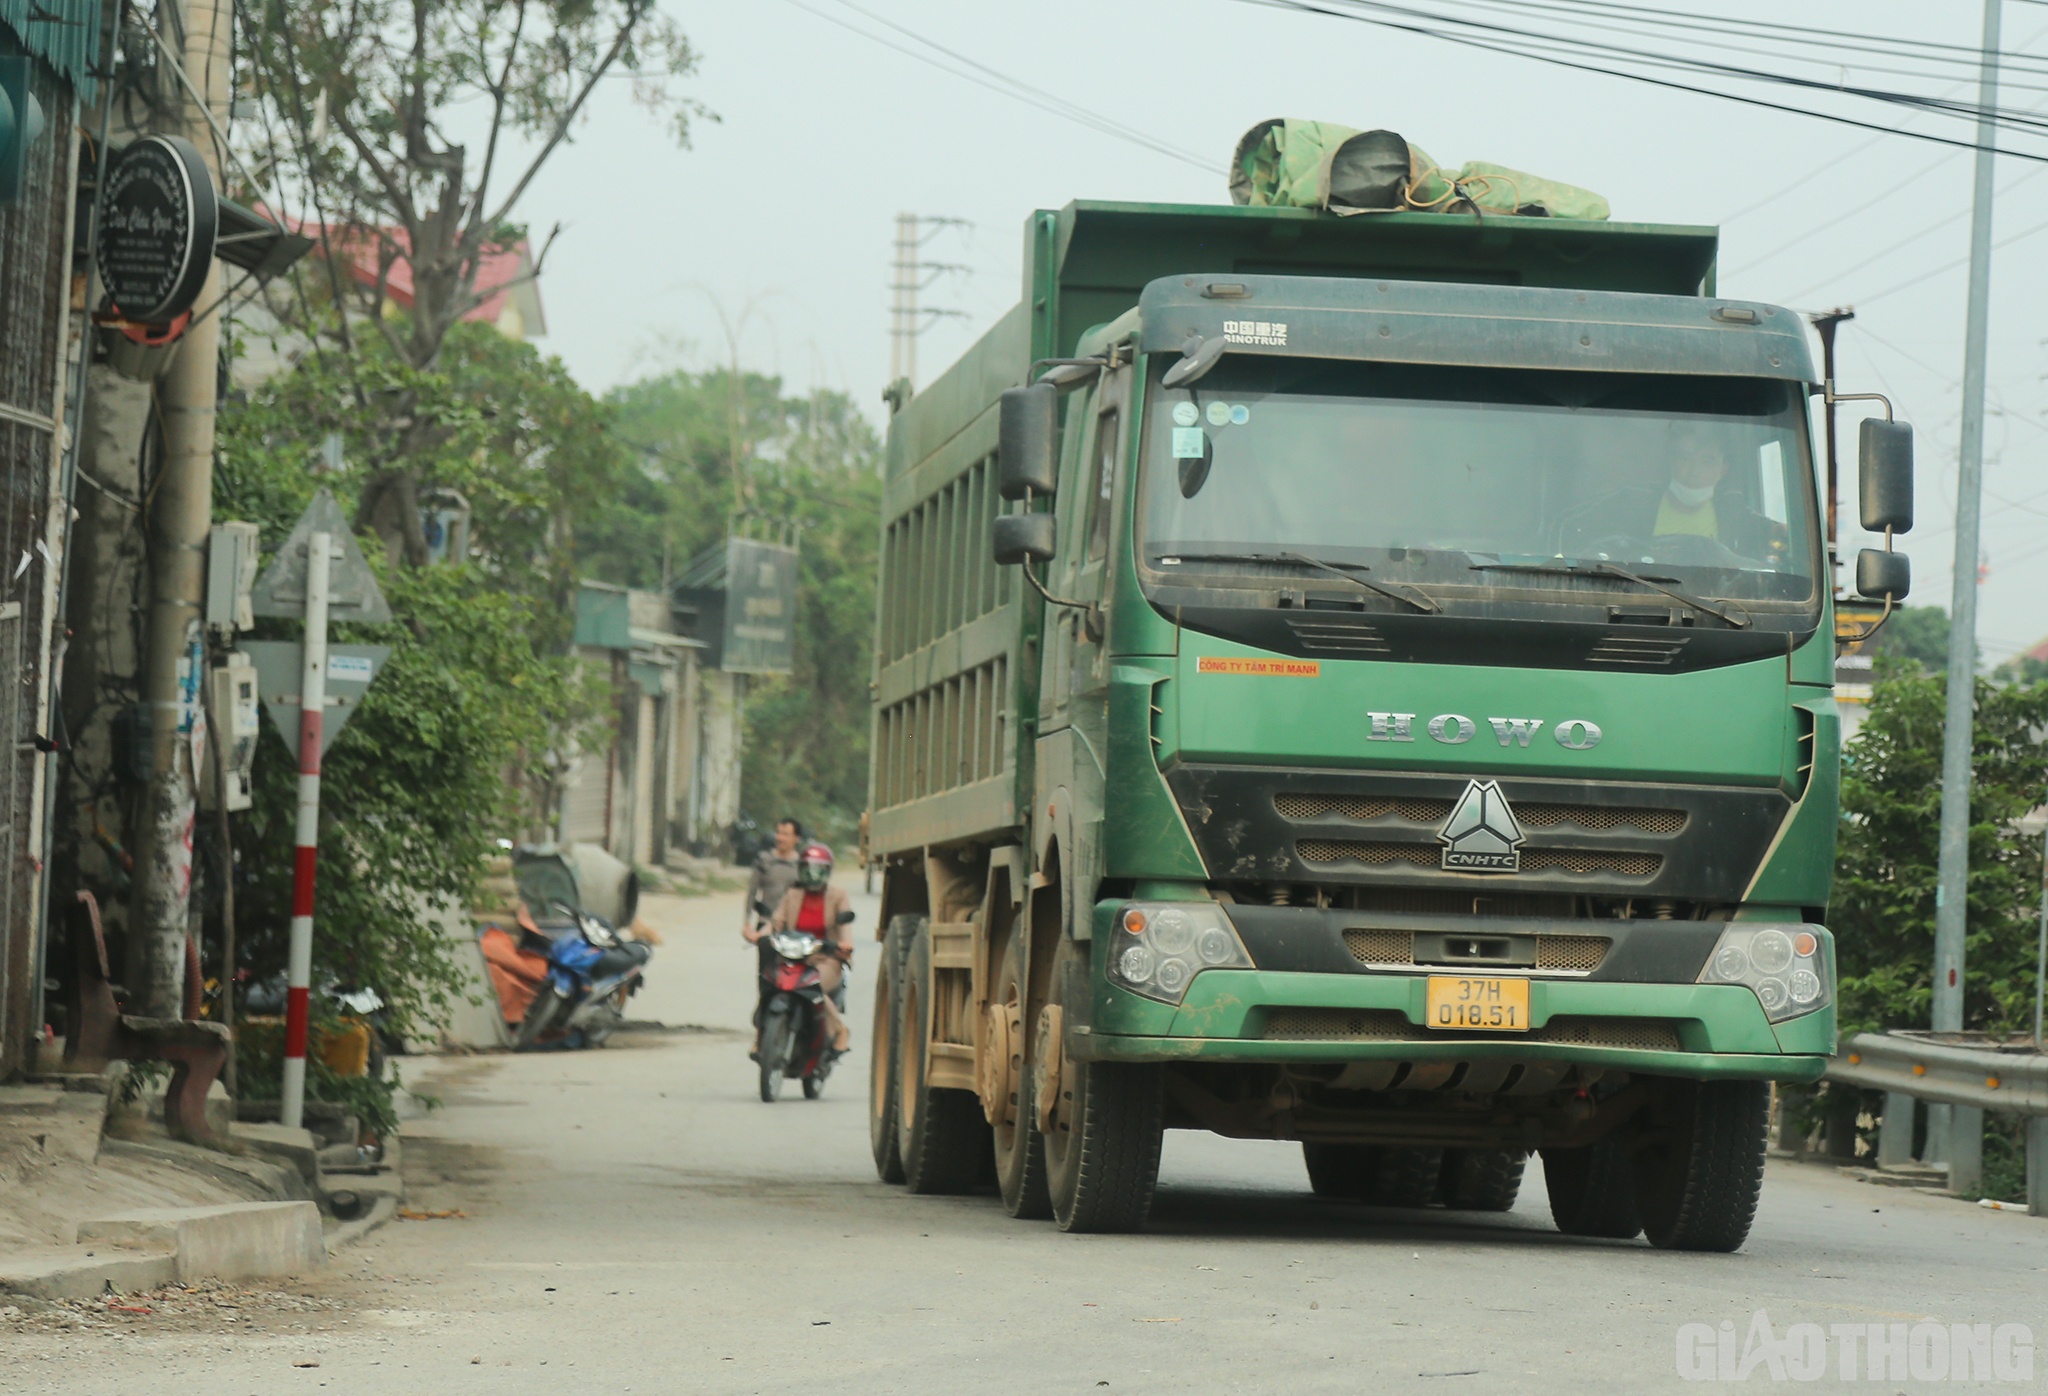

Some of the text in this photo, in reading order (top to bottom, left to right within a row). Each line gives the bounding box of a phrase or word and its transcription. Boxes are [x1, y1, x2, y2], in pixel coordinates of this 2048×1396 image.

[1223, 334, 1287, 346] SINOTRUK
[1199, 660, 1227, 671] CÔNG
[1230, 662, 1242, 672] TY
[1269, 662, 1285, 673] TRÍ
[1287, 664, 1317, 676] MẠNH
[1366, 712, 1603, 750] HOWO
[1447, 854, 1515, 866] CNHTC
[1458, 980, 1501, 1001] 37H
[1439, 1003, 1516, 1027] 018.51
